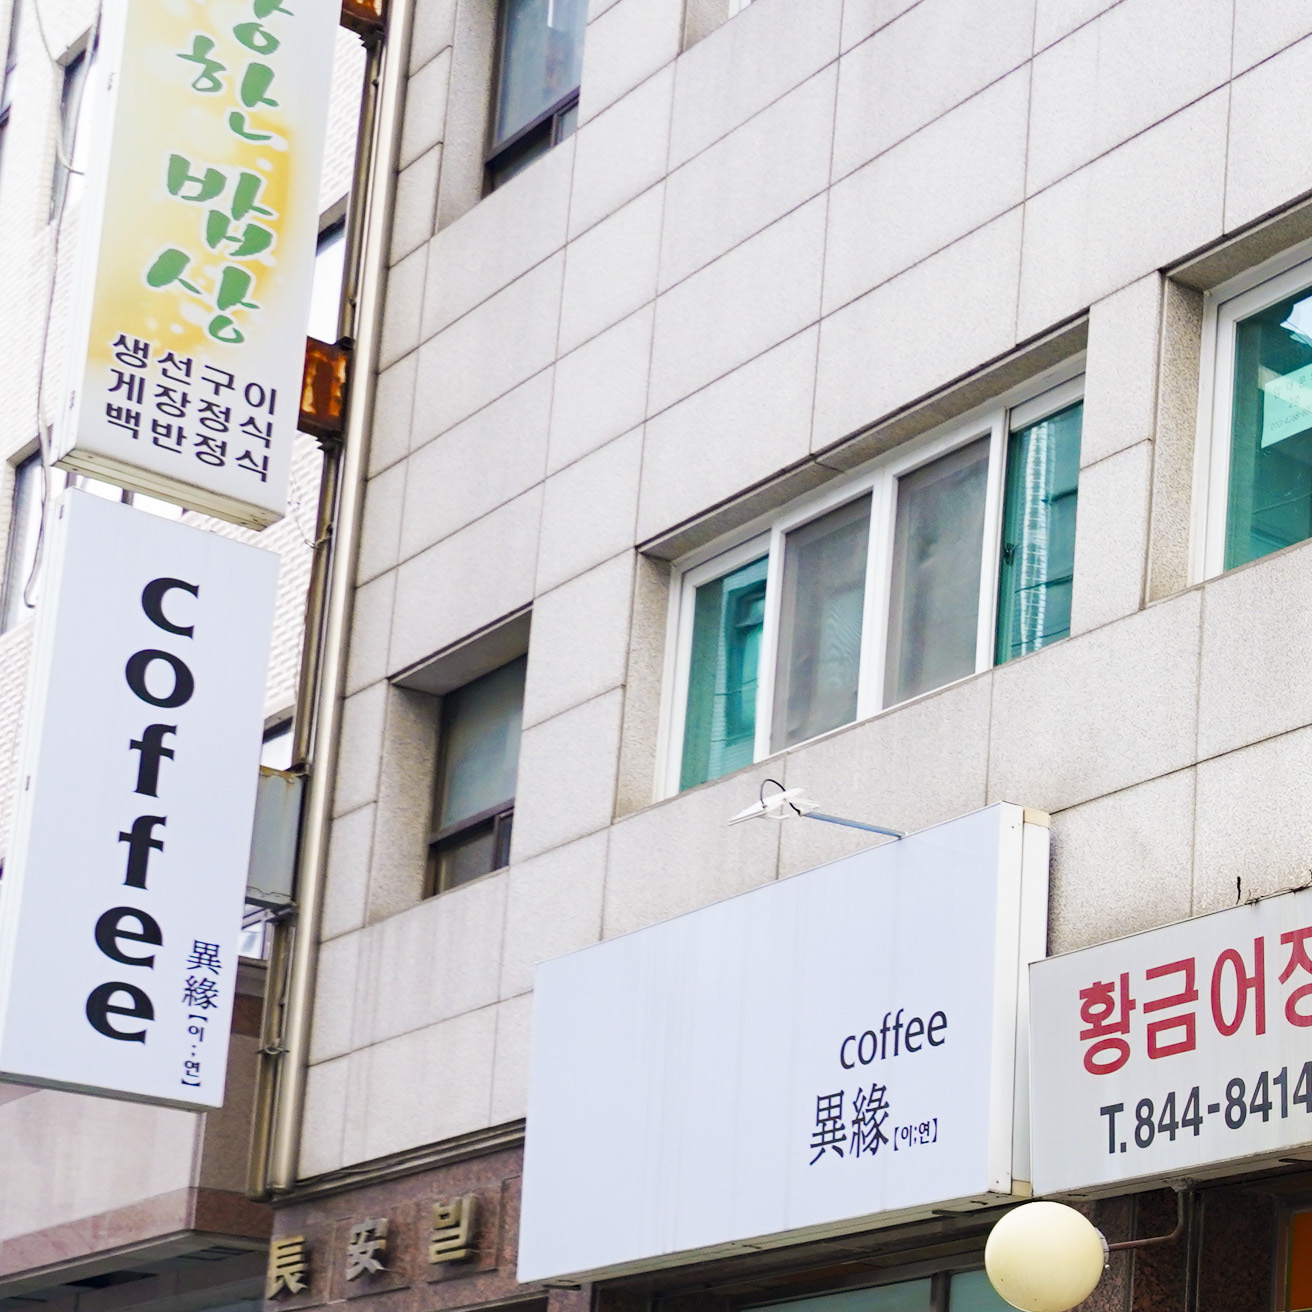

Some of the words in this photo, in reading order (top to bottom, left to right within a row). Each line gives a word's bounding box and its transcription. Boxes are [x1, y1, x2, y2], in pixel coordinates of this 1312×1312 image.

[147, 153, 277, 345] 밥상
[107, 368, 273, 449] 게장정식
[112, 334, 277, 416] 생선구이
[105, 402, 270, 483] 백반정식
[85, 577, 200, 1046] coffee
[840, 1009, 948, 1070] coffee
